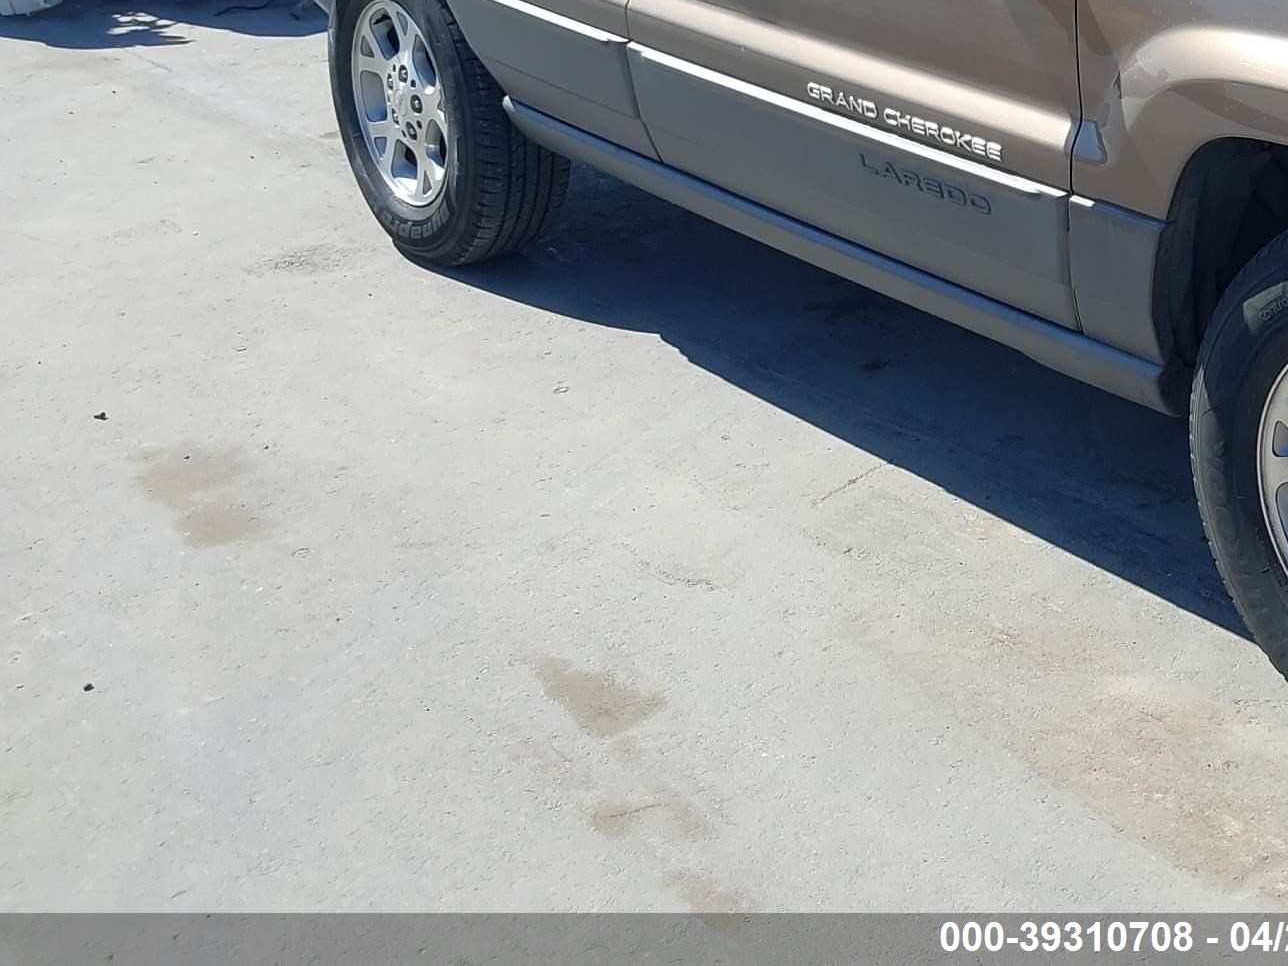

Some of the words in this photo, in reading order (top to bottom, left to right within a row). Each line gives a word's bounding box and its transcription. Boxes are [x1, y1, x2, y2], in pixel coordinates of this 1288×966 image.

[807, 82, 878, 119] GRAND
[883, 107, 1003, 163] CHEROKEE
[858, 153, 993, 216] LAREDO
